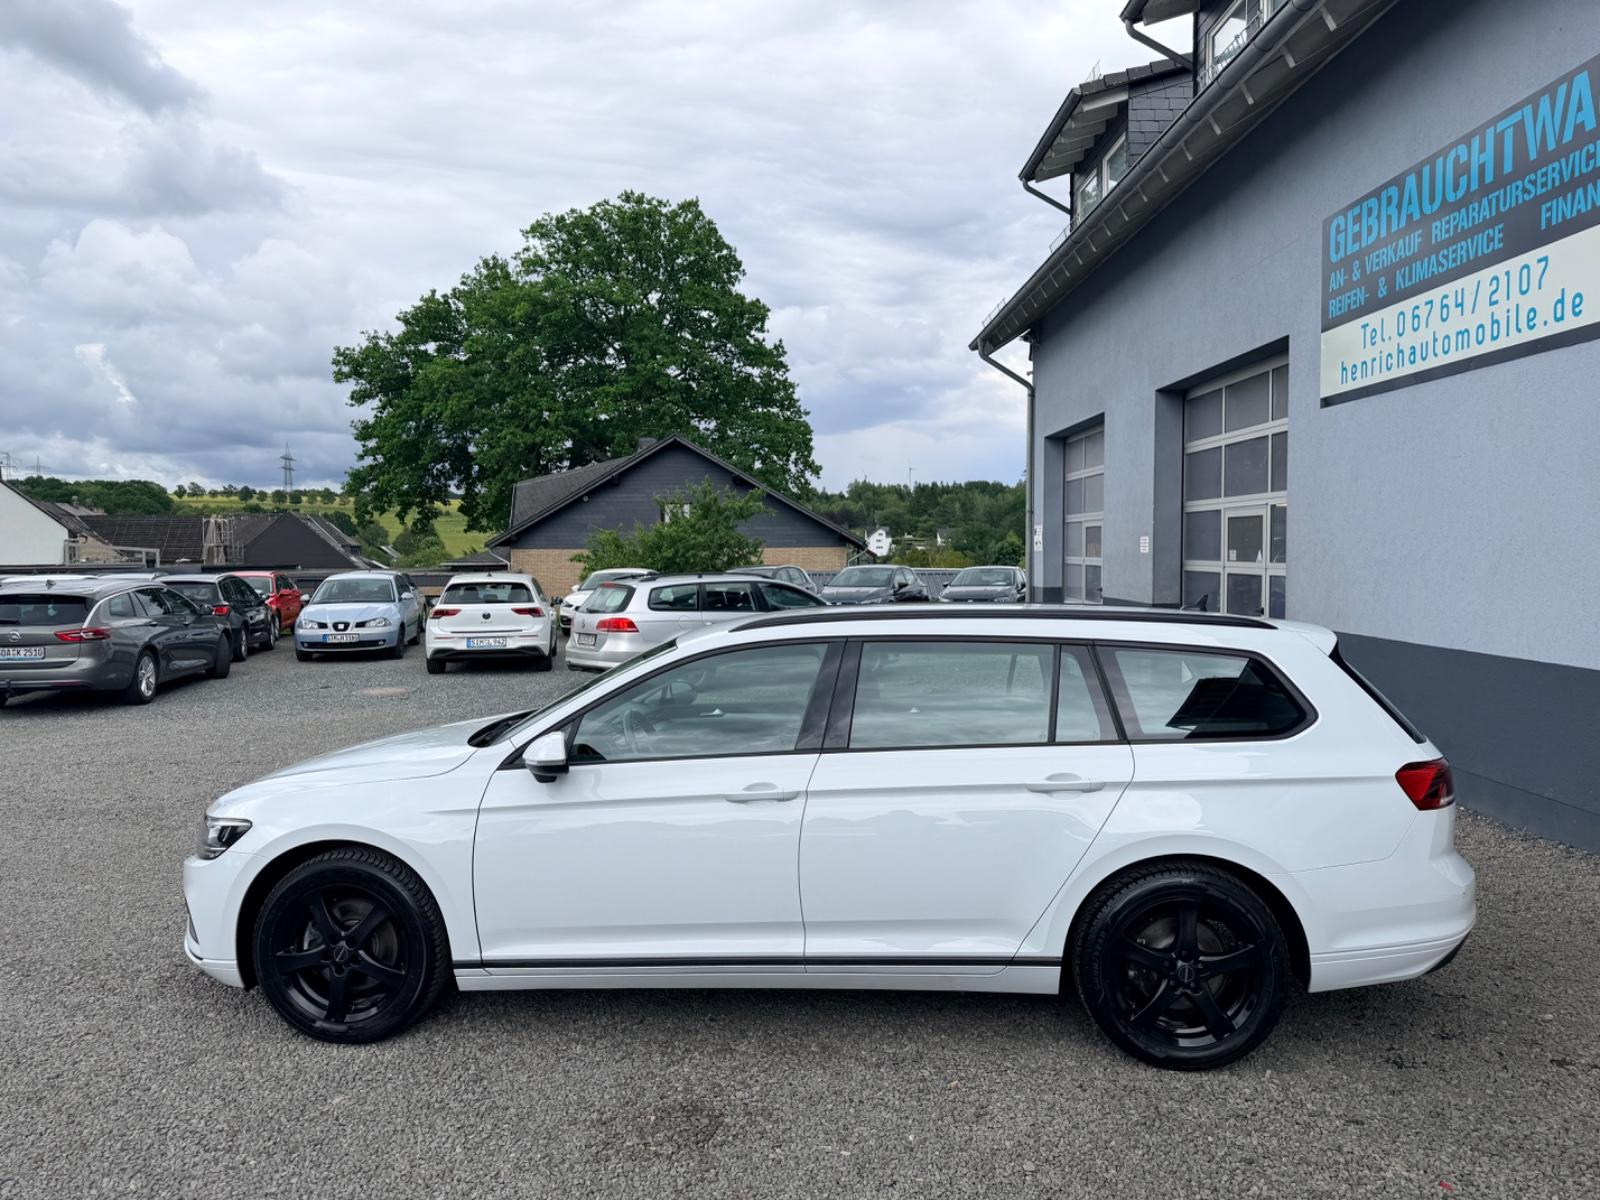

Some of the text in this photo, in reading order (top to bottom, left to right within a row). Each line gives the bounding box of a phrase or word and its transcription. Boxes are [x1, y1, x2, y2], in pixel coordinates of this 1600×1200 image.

[1329, 69, 1600, 264] GEBRAUCHTWA
[1329, 271, 1349, 293] AN-
[1352, 259, 1362, 282] &
[1365, 229, 1423, 275] VERKAUF
[1329, 292, 1370, 319] REIFEN-
[1377, 275, 1388, 299] &
[1396, 223, 1504, 291] KLIMASERVICE
[1340, 287, 1585, 385] henrichautomobile.de
[0, 648, 10, 657] OA
